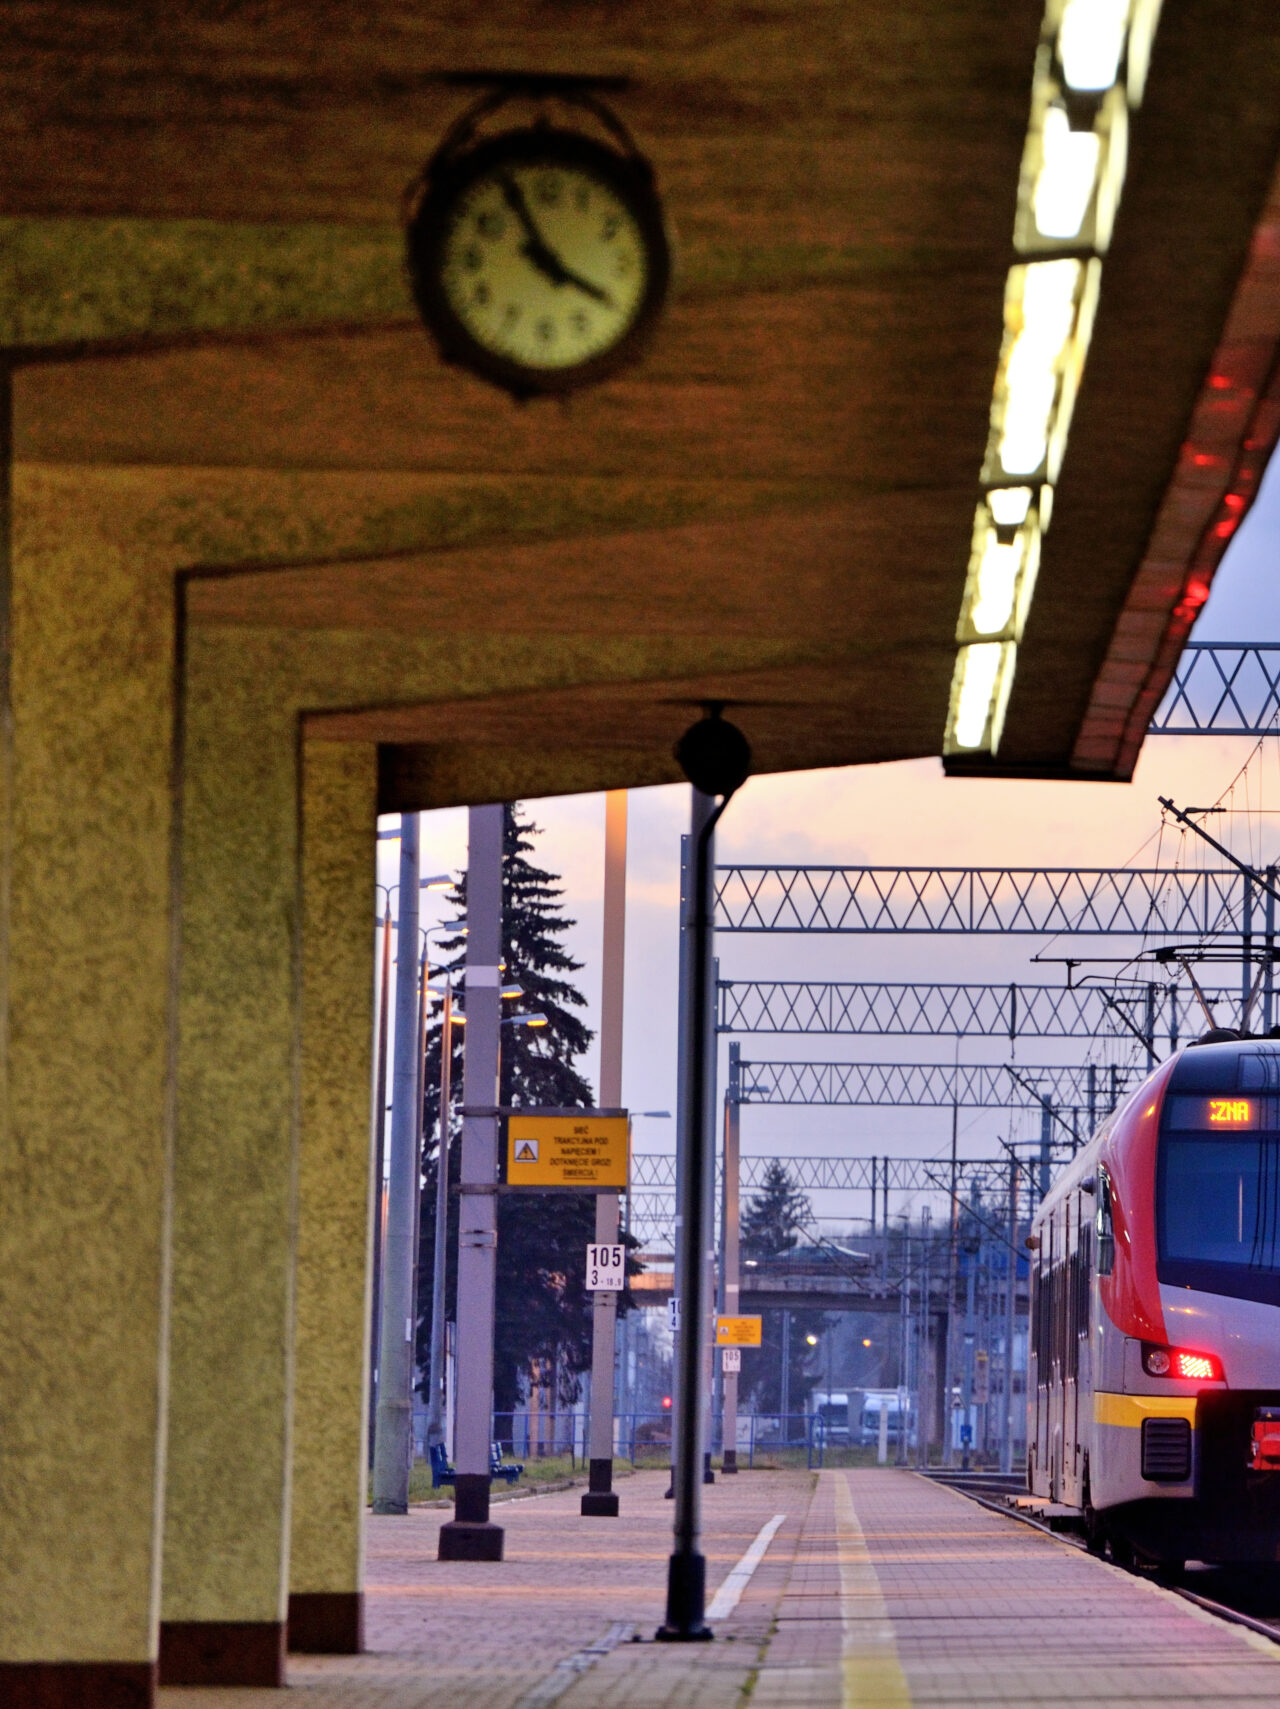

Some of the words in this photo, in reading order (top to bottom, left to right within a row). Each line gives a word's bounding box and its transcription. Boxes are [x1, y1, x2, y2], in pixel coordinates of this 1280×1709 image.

[554, 1137, 593, 1145] TRAKCYJNA
[594, 1137, 609, 1145] POD
[561, 1147, 597, 1156] NAPIĘCIEM
[591, 1247, 621, 1267] 105
[591, 1270, 598, 1285] 3
